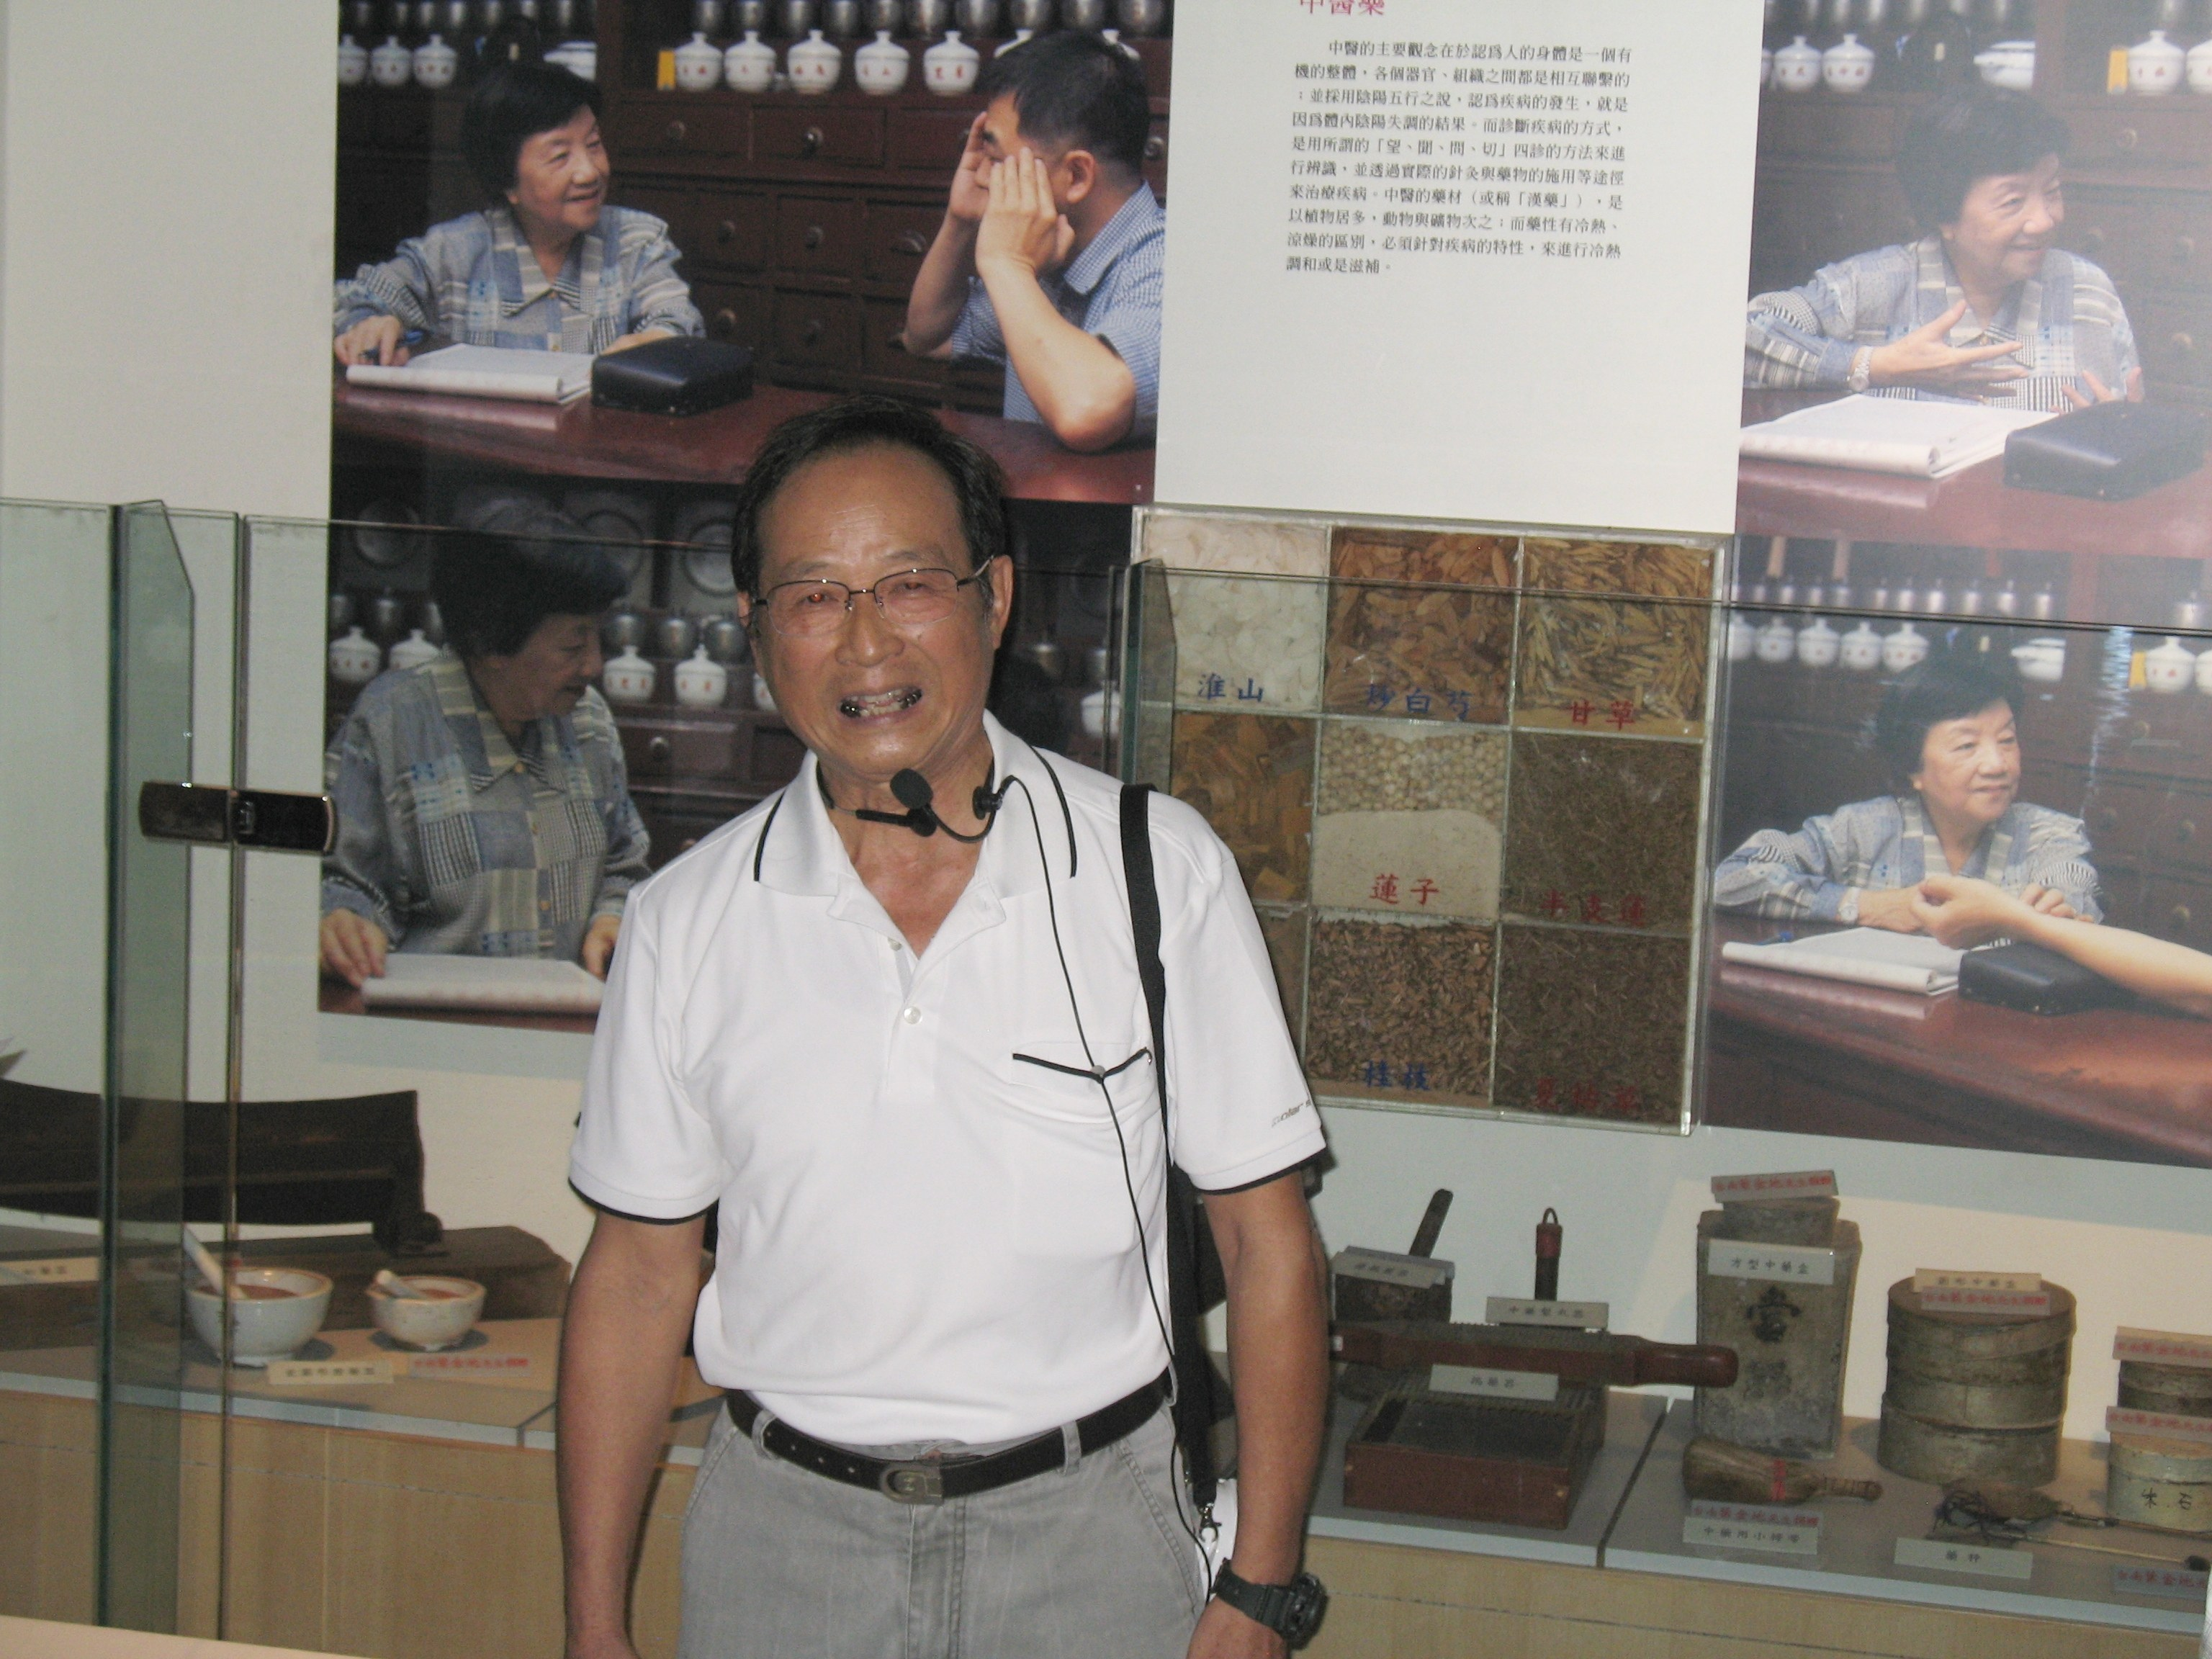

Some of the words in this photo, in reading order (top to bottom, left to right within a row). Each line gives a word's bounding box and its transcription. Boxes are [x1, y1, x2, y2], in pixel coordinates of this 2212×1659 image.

[1287, 255, 1391, 274] 調和或是滋補。
[1198, 672, 1264, 703] 淮山
[1570, 698, 1637, 732] 甘草
[1370, 873, 1439, 905] 蓮子
